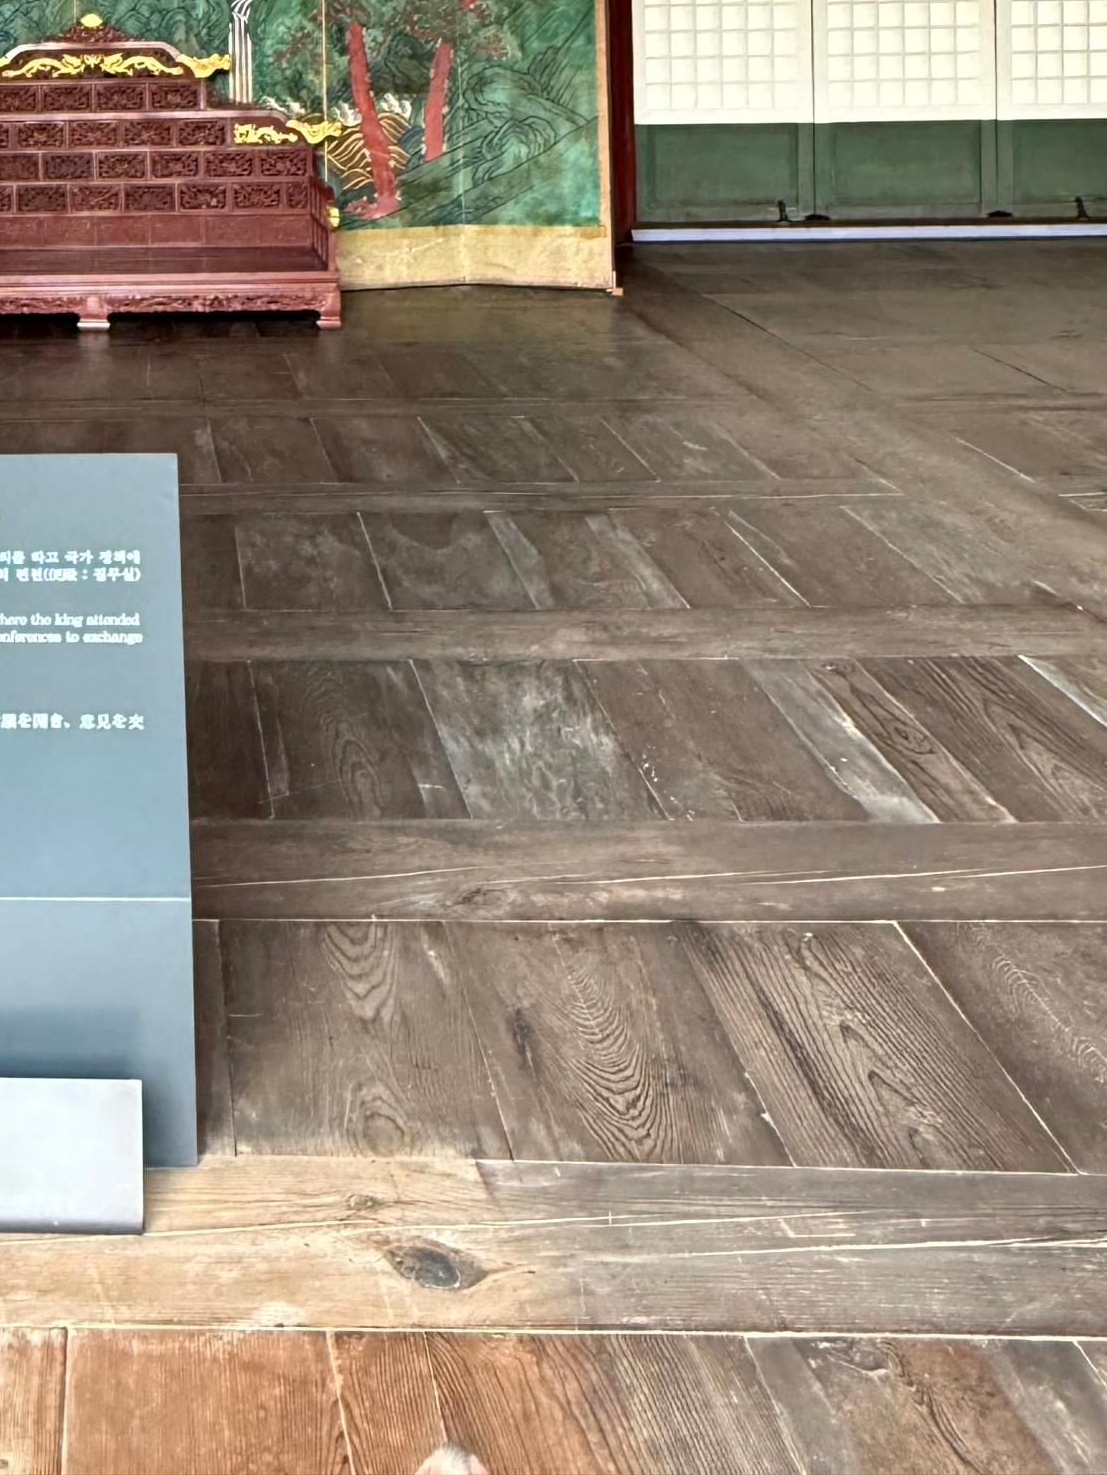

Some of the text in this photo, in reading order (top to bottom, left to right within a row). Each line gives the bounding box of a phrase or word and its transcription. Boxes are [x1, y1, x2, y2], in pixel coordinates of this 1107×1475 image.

[31, 550, 59, 565] 하고
[64, 549, 94, 565] 국가
[99, 549, 141, 565] 정책에
[30, 612, 52, 626] the
[54, 612, 84, 628] king
[86, 612, 141, 626] attended
[65, 630, 80, 643] to
[82, 630, 144, 646] exchange
